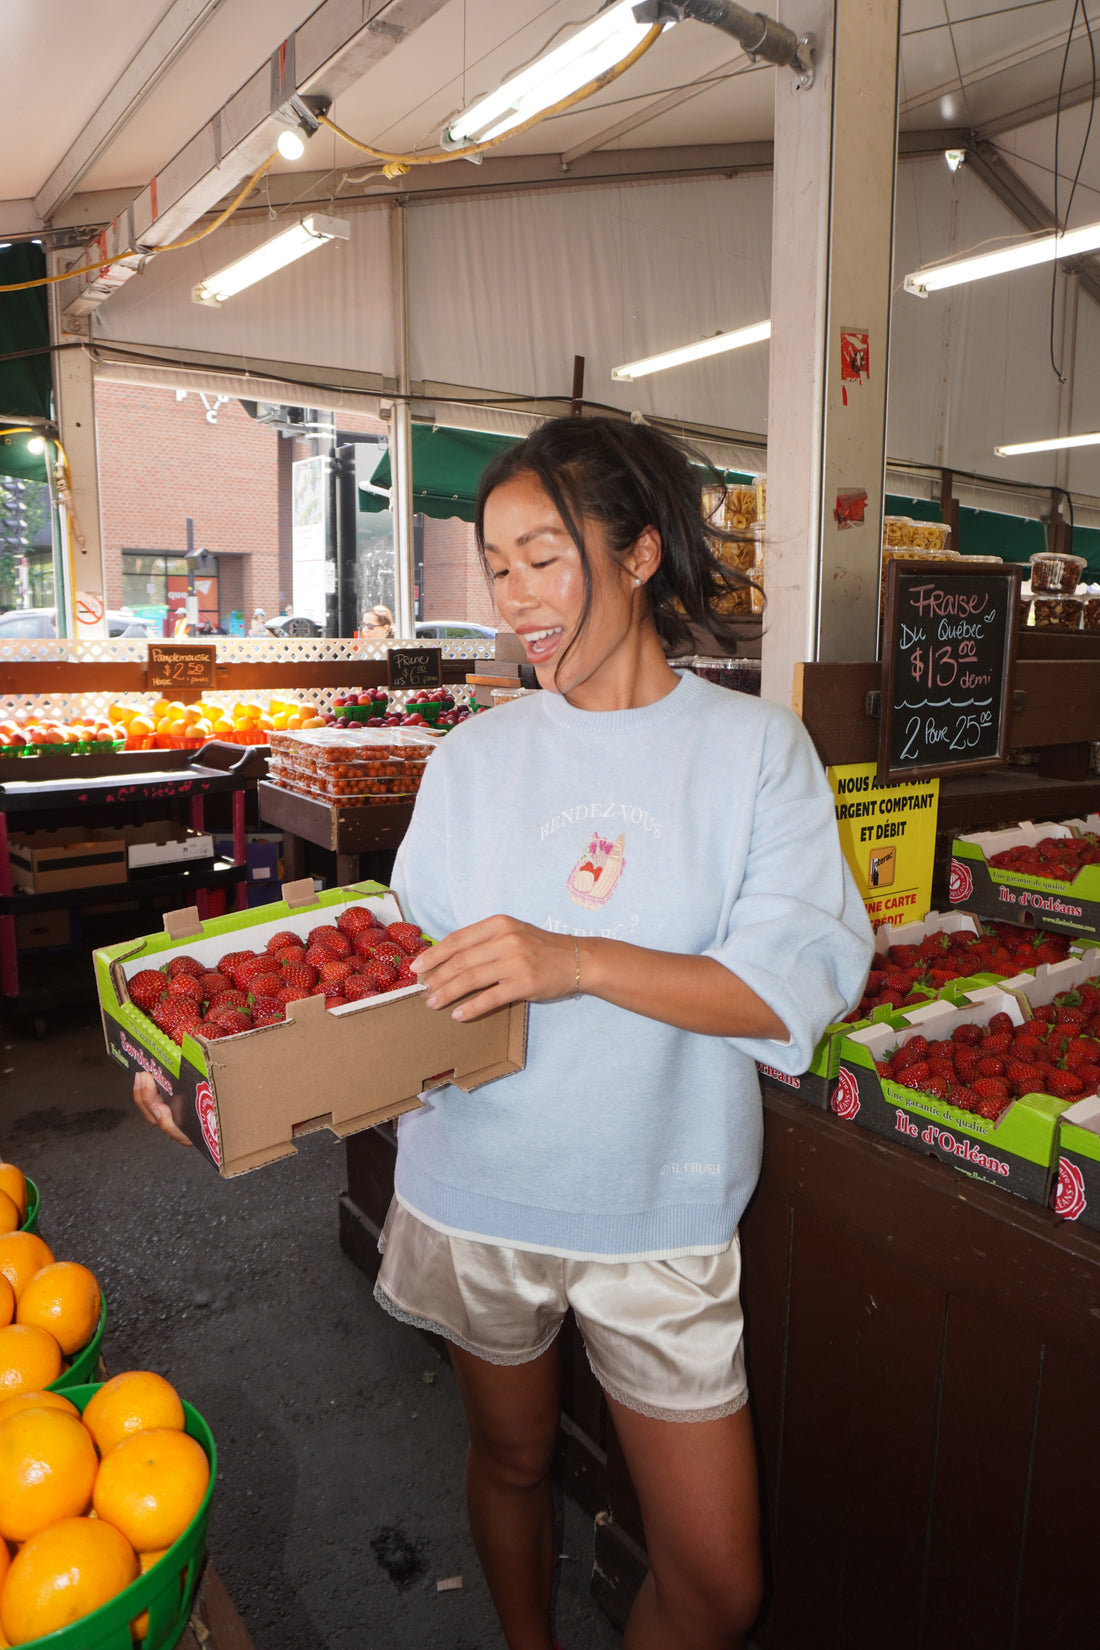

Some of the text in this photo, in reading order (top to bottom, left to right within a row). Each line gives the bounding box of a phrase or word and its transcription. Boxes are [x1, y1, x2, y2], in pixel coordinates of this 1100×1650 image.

[938, 618, 984, 641] Québec
[900, 716, 921, 759] 2
[838, 776, 869, 795] NOUS
[878, 793, 934, 815] COMPTANT
[860, 819, 907, 842] ET DÉBIT
[993, 871, 1005, 879] Une
[1006, 875, 1031, 885] garantie
[1043, 881, 1066, 891] qualité
[885, 894, 917, 909] CARTE
[999, 885, 1082, 917] Île d'Orléans
[886, 1087, 988, 1136] Une garantie de qualité
[895, 1109, 1010, 1177] Île d'Orléans
